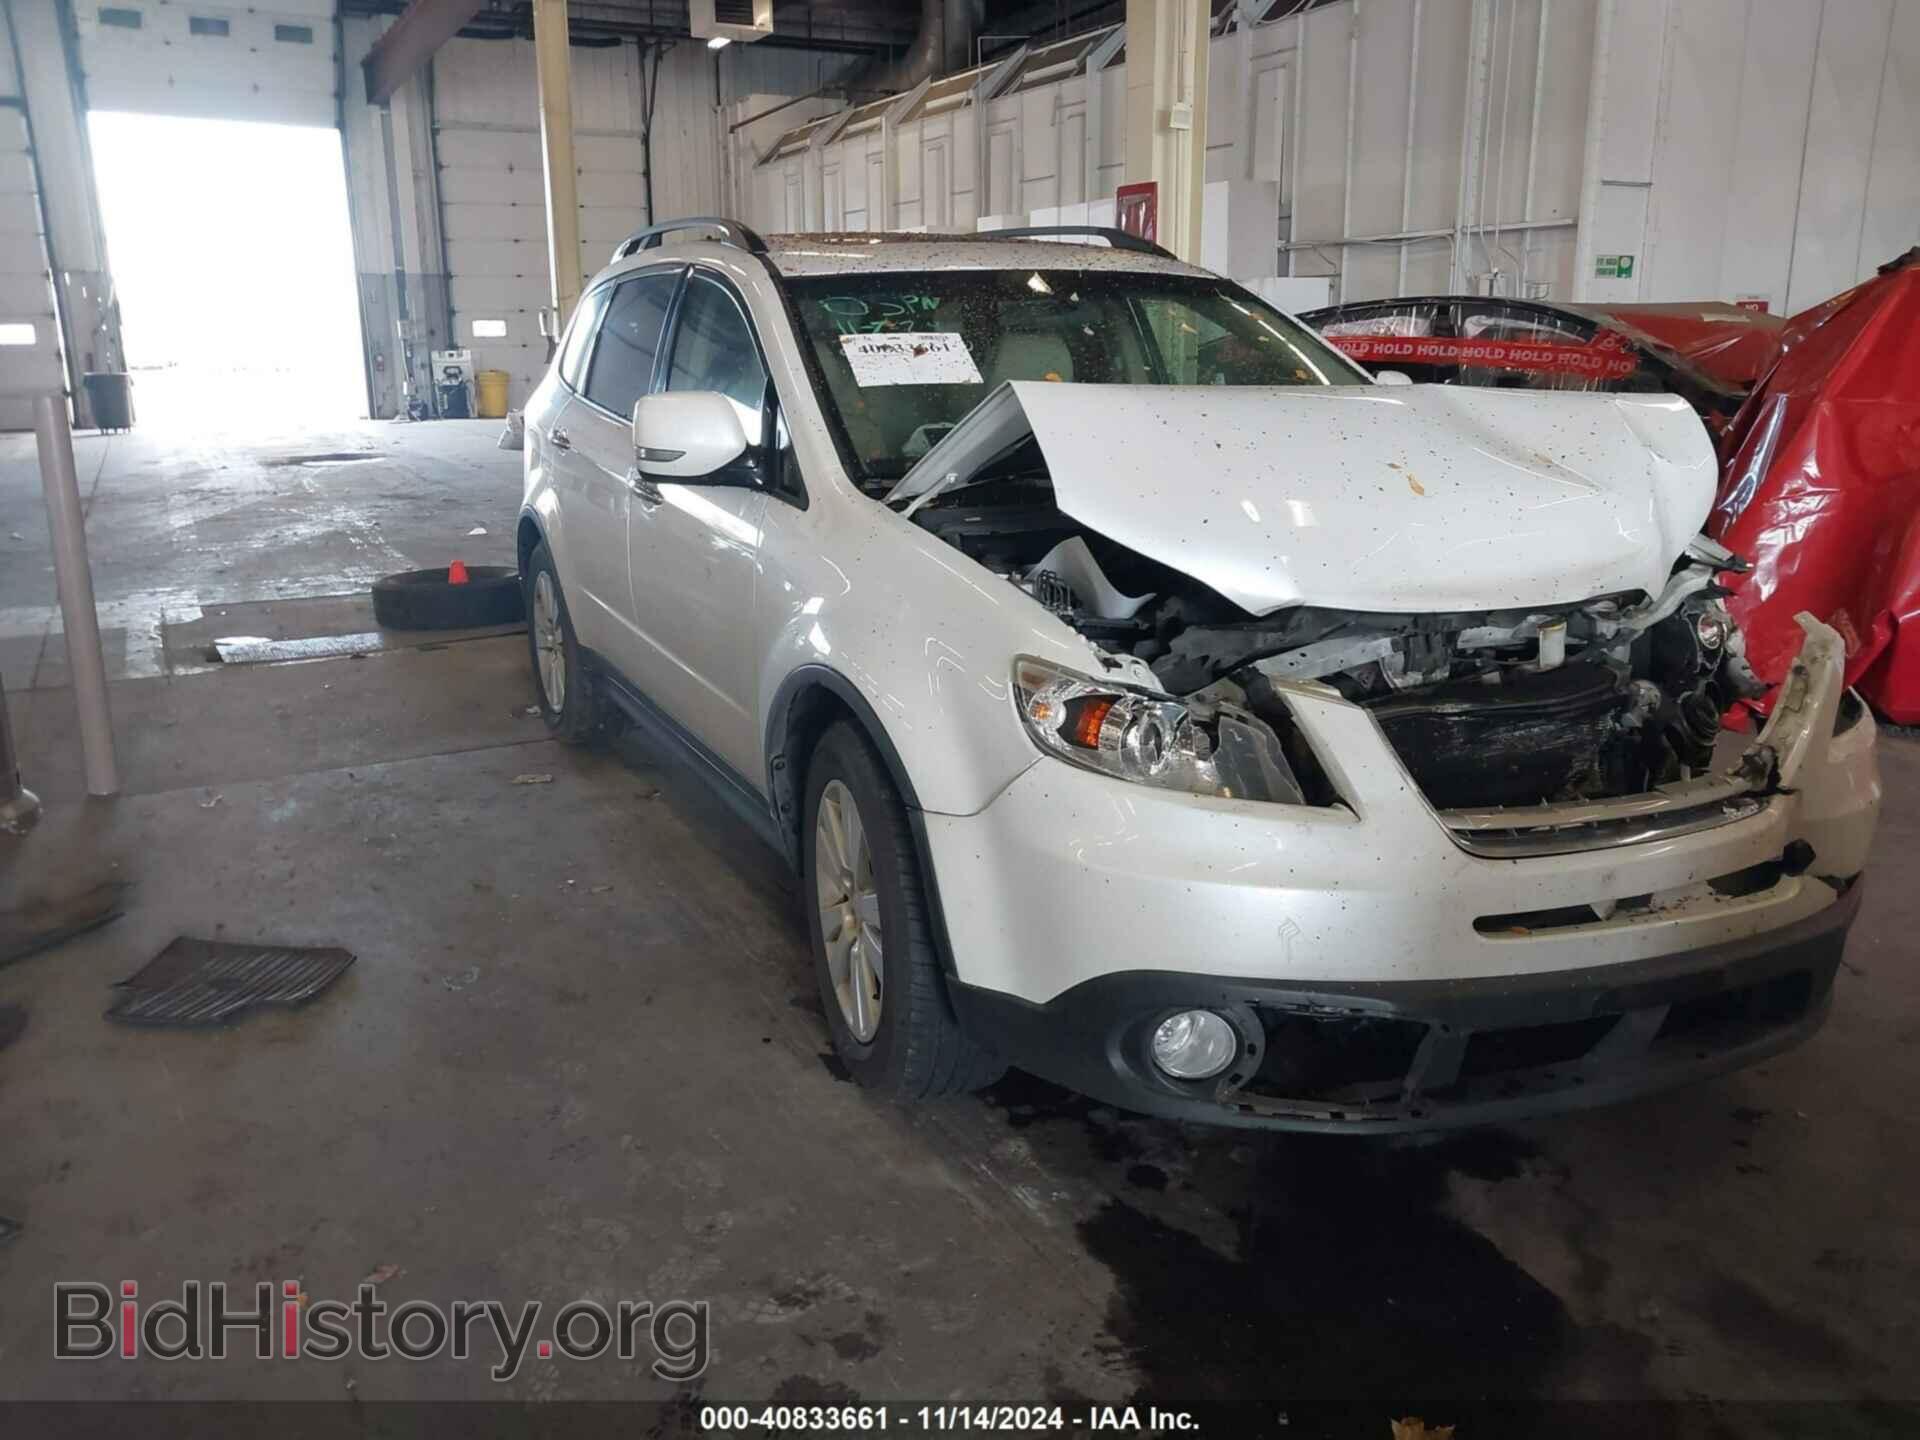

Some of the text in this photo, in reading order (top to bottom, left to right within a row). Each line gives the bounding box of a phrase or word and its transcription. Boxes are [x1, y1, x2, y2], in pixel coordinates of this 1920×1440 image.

[1373, 343, 1413, 355] HOLD
[1417, 344, 1457, 357] HOLD
[1461, 346, 1505, 360] HOLD
[1509, 349, 1553, 362] HOLD
[1557, 353, 1603, 369] HOLD
